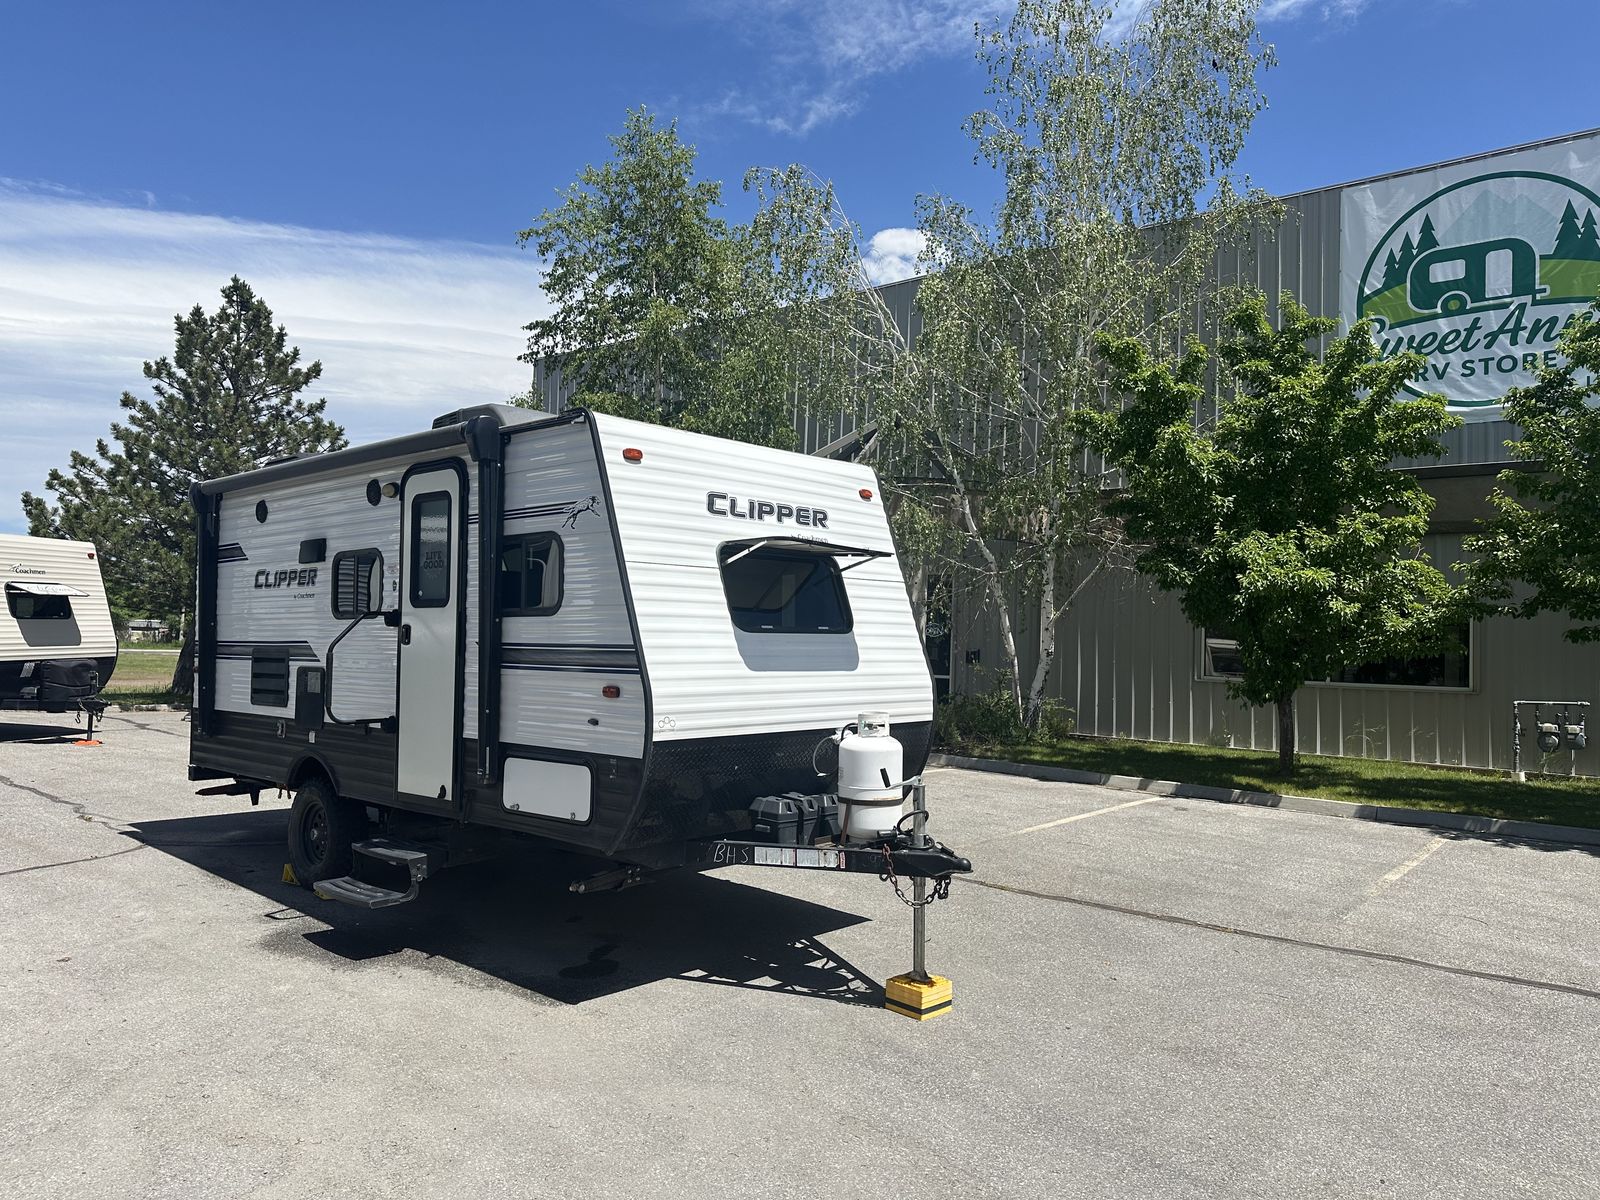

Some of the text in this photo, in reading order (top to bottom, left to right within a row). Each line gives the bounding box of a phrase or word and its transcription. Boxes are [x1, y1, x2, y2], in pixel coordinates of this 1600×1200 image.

[1413, 350, 1558, 383] RV STORE
[706, 491, 829, 529] CLIPPER
[15, 567, 46, 575] Coachmen
[423, 560, 444, 570] GOOD
[254, 567, 318, 589] CLIPPER
